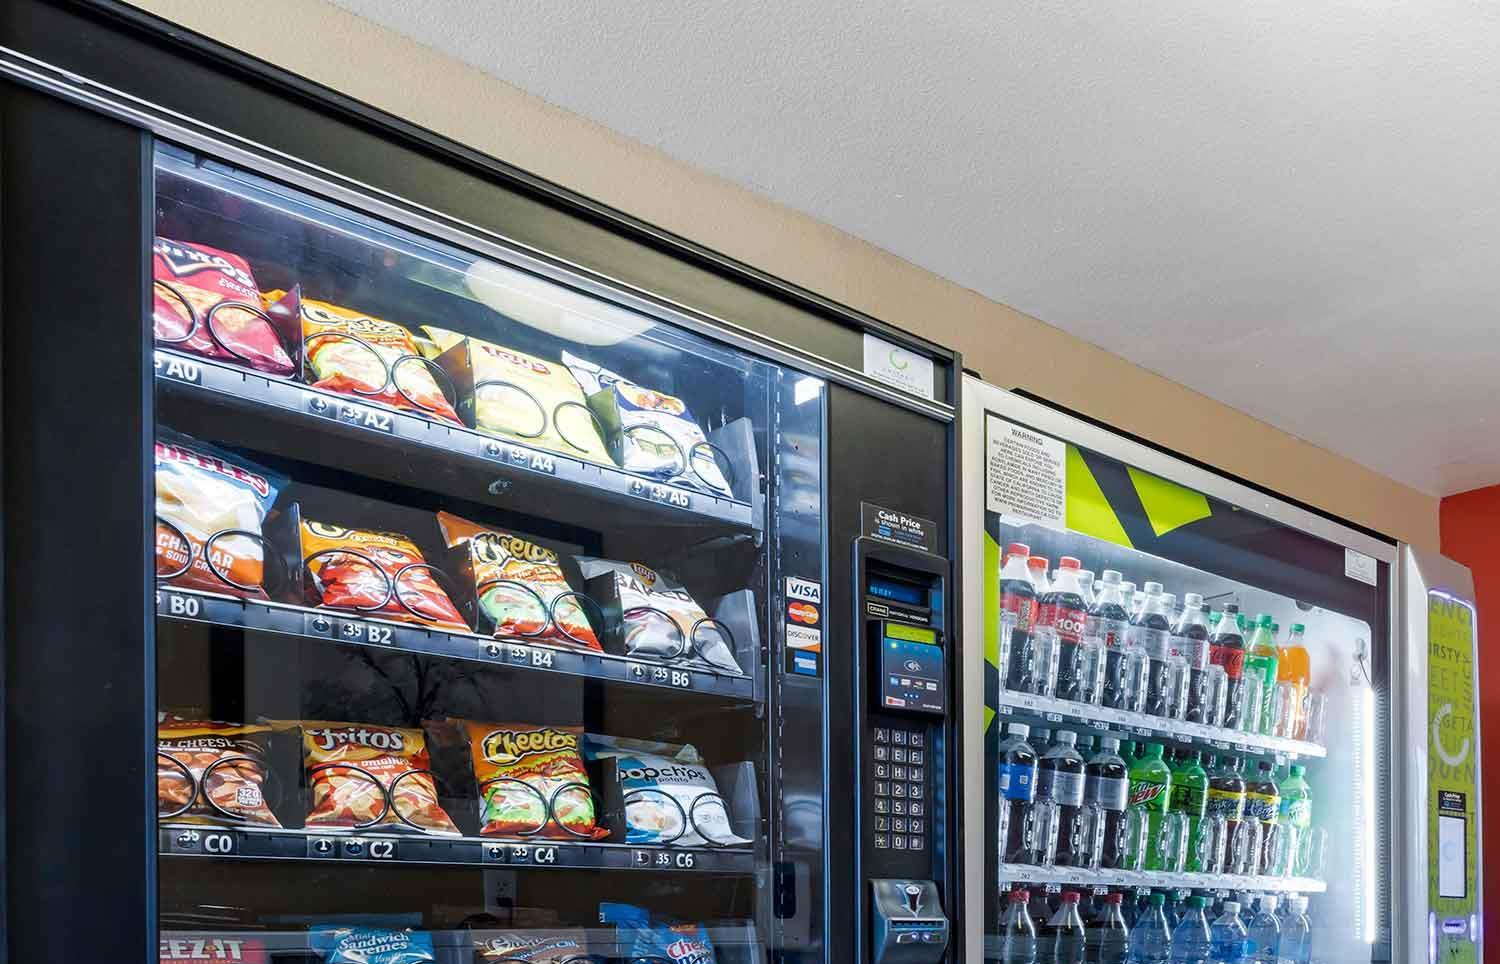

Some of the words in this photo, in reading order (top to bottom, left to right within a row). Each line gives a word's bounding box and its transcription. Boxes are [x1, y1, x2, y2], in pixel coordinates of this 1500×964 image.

[166, 357, 199, 382] A0
[364, 411, 391, 431] A2
[530, 455, 554, 473] A4
[669, 489, 690, 508] A6
[878, 510, 899, 524] Cash
[900, 516, 921, 530] Price
[789, 582, 821, 600] VISA
[170, 594, 200, 618] B0
[367, 626, 392, 645] B2
[787, 629, 820, 642] DISCOVER
[531, 648, 553, 668] B4
[670, 670, 690, 688] B6
[481, 727, 577, 767] Cheetos
[204, 834, 233, 853] C0
[369, 841, 394, 860] C2
[533, 845, 555, 865] C4
[655, 852, 670, 866] .35
[675, 851, 694, 869] C6
[339, 932, 409, 950] Sandwich
